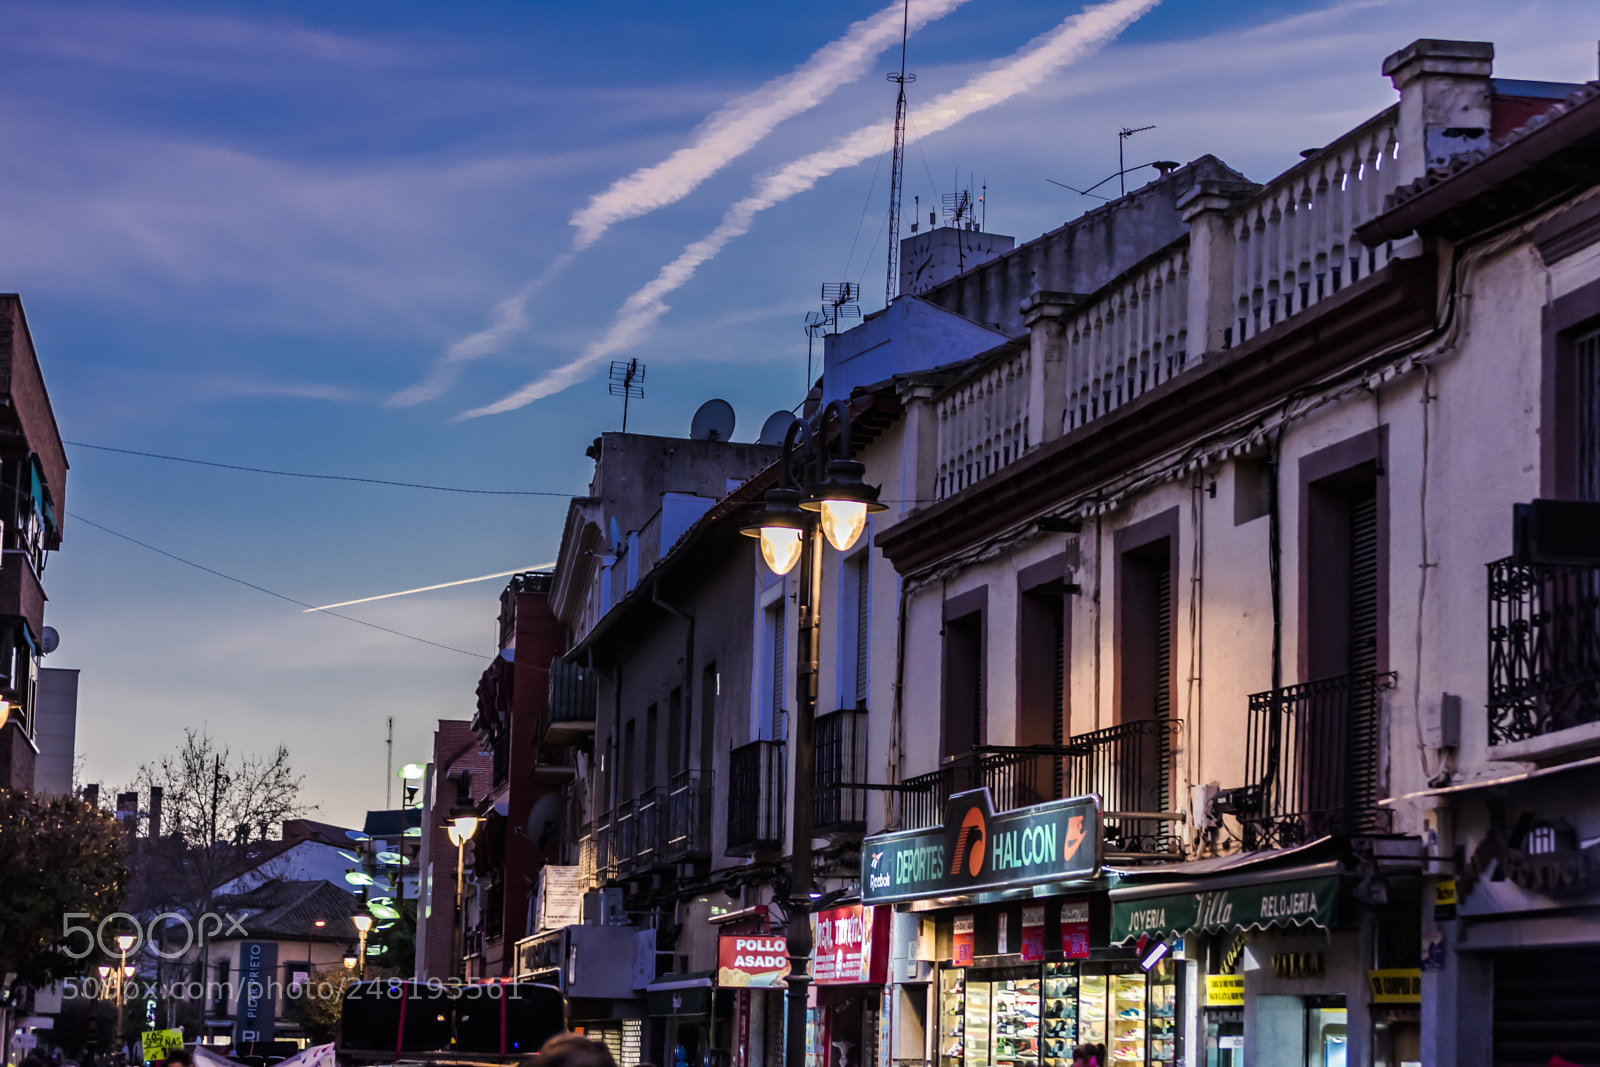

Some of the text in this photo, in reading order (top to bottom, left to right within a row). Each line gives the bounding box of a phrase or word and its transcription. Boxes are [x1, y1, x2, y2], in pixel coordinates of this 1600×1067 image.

[896, 845, 944, 885] DEPORTES
[992, 822, 1056, 871] HALCON
[870, 872, 891, 892] Reebok
[1128, 908, 1166, 932] JOYERIA
[1260, 892, 1318, 917] RELOJERIA
[736, 938, 786, 953] POLLO
[248, 944, 261, 985] PRIETO
[733, 954, 787, 968] ASADO
[146, 1032, 163, 1042] LOS
